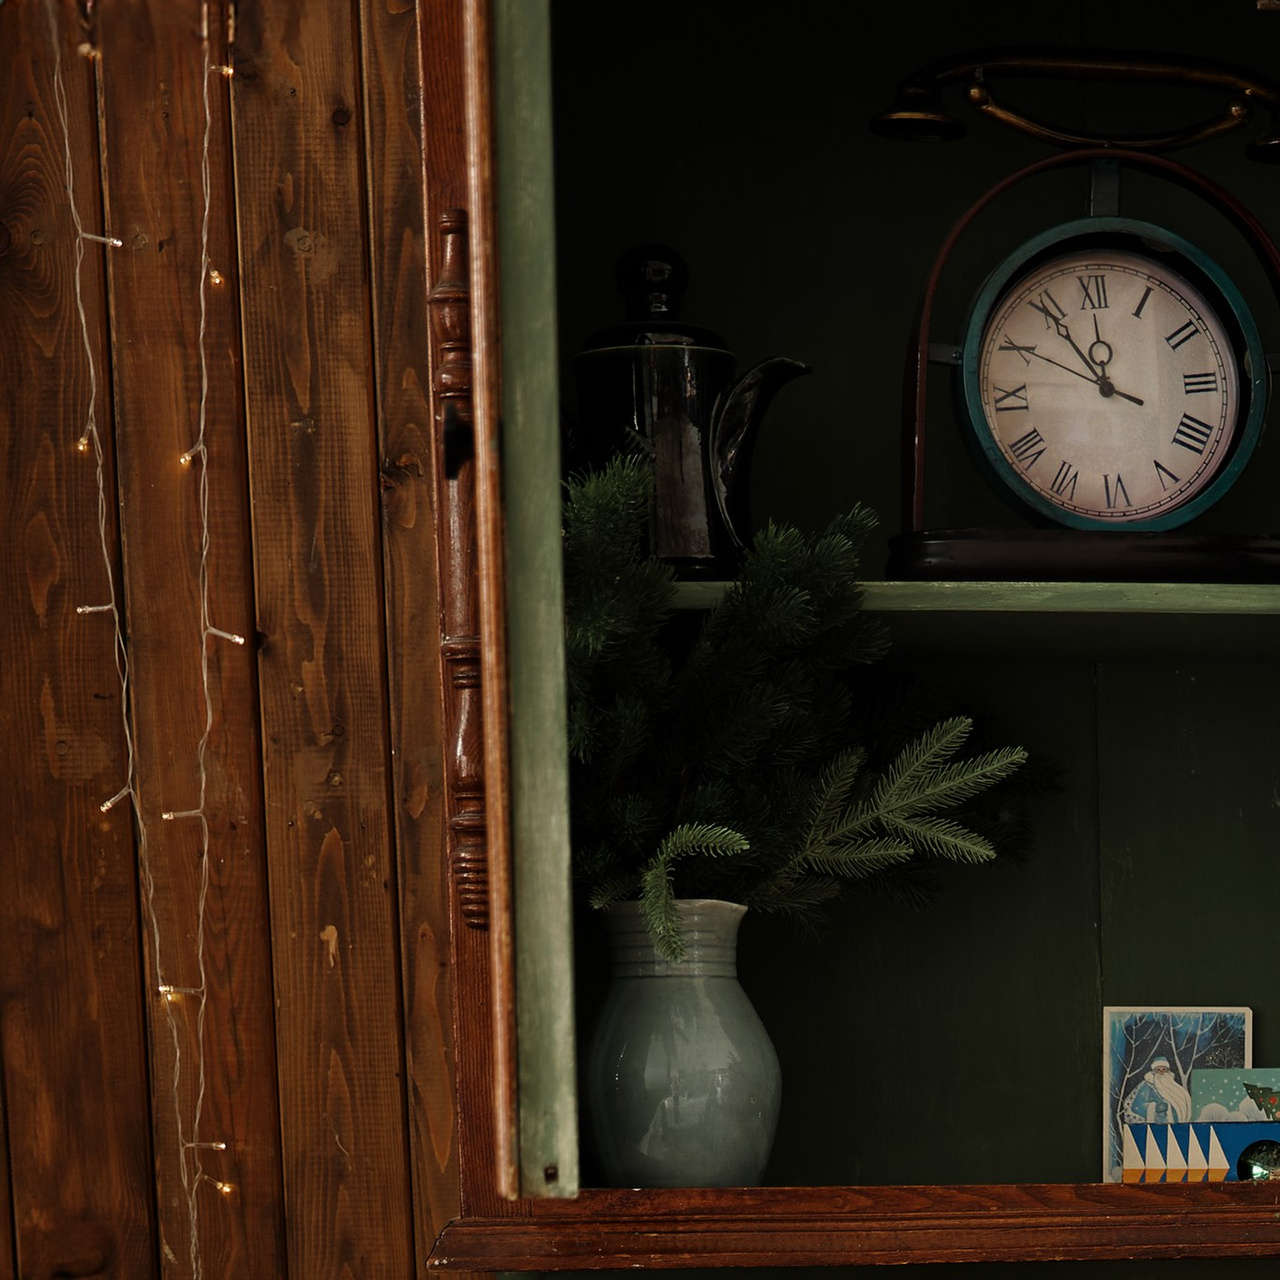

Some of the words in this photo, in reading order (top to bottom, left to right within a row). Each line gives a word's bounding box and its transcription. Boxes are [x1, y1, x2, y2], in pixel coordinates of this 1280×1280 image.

[1076, 275, 1109, 310] XII
[1132, 285, 1154, 319] I
[998, 334, 1037, 366] X
[1164, 319, 1201, 352] II
[993, 383, 1030, 414] IX
[1183, 372, 1218, 394] III
[1008, 427, 1047, 471] VIII
[1172, 412, 1214, 455] IIII
[1050, 461, 1079, 501] VII
[1103, 473, 1133, 508] VI
[1153, 459, 1181, 491] V
